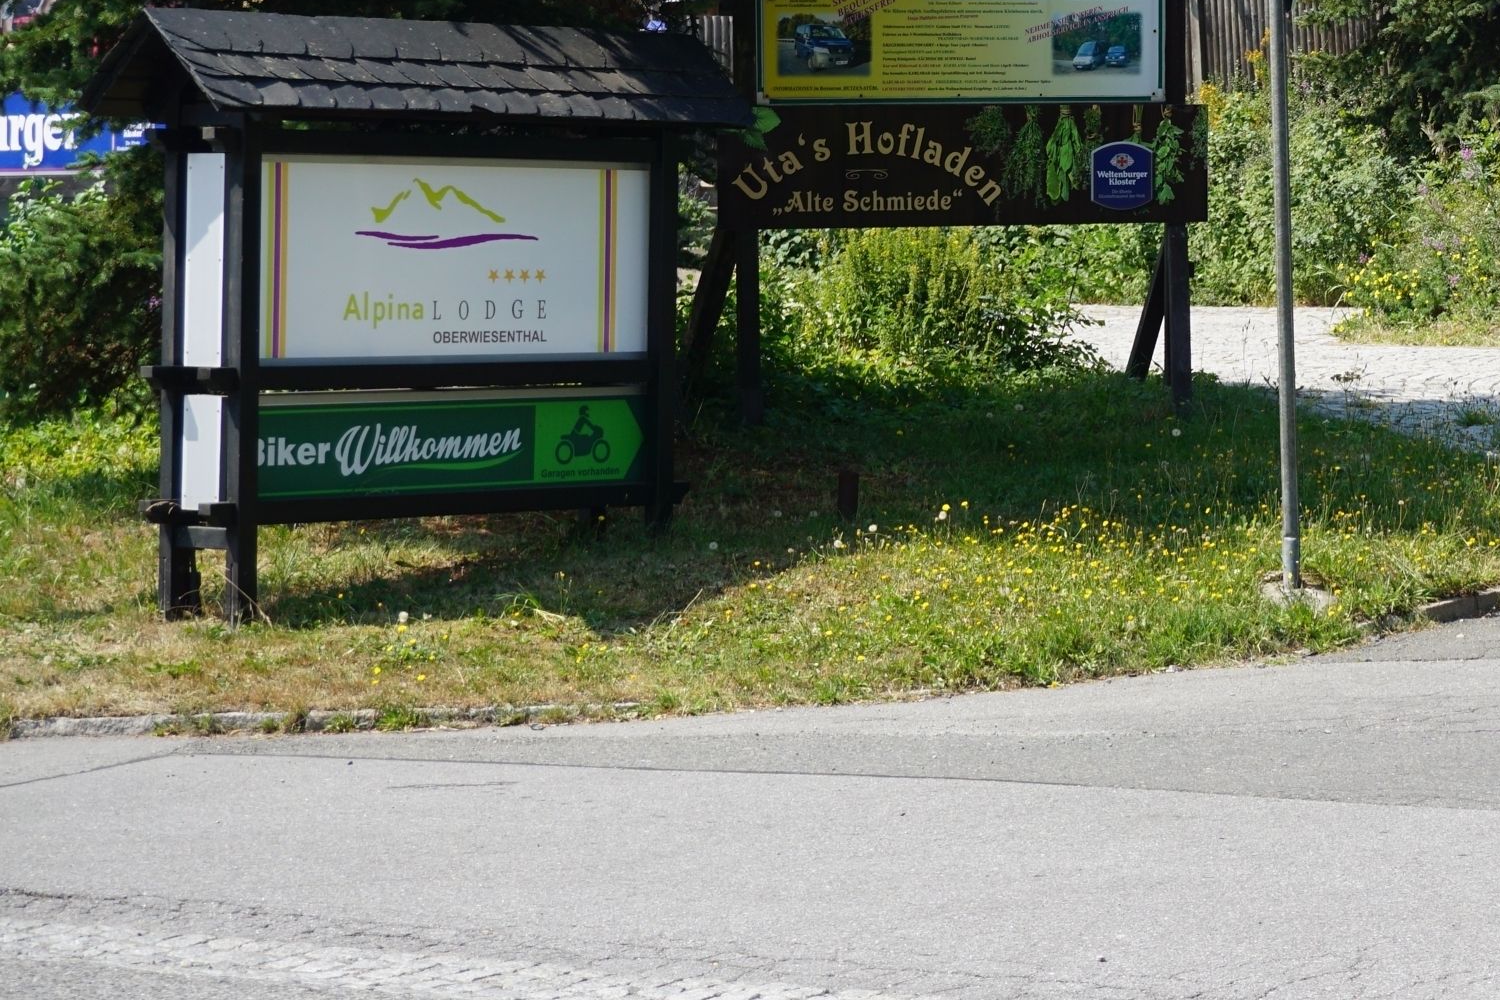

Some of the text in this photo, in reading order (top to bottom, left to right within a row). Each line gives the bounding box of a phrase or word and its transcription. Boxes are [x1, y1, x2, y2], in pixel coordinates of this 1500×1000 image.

[731, 121, 1002, 207] Uta's Hofladen
[1096, 170, 1148, 179] Weltenburger
[1108, 177, 1137, 186] Kloster
[343, 291, 547, 329] Alpina LODGE
[433, 330, 547, 344] OBERWIESENTHAL
[335, 423, 521, 476] Willkommen
[541, 466, 619, 479] Garagen vorhanden
